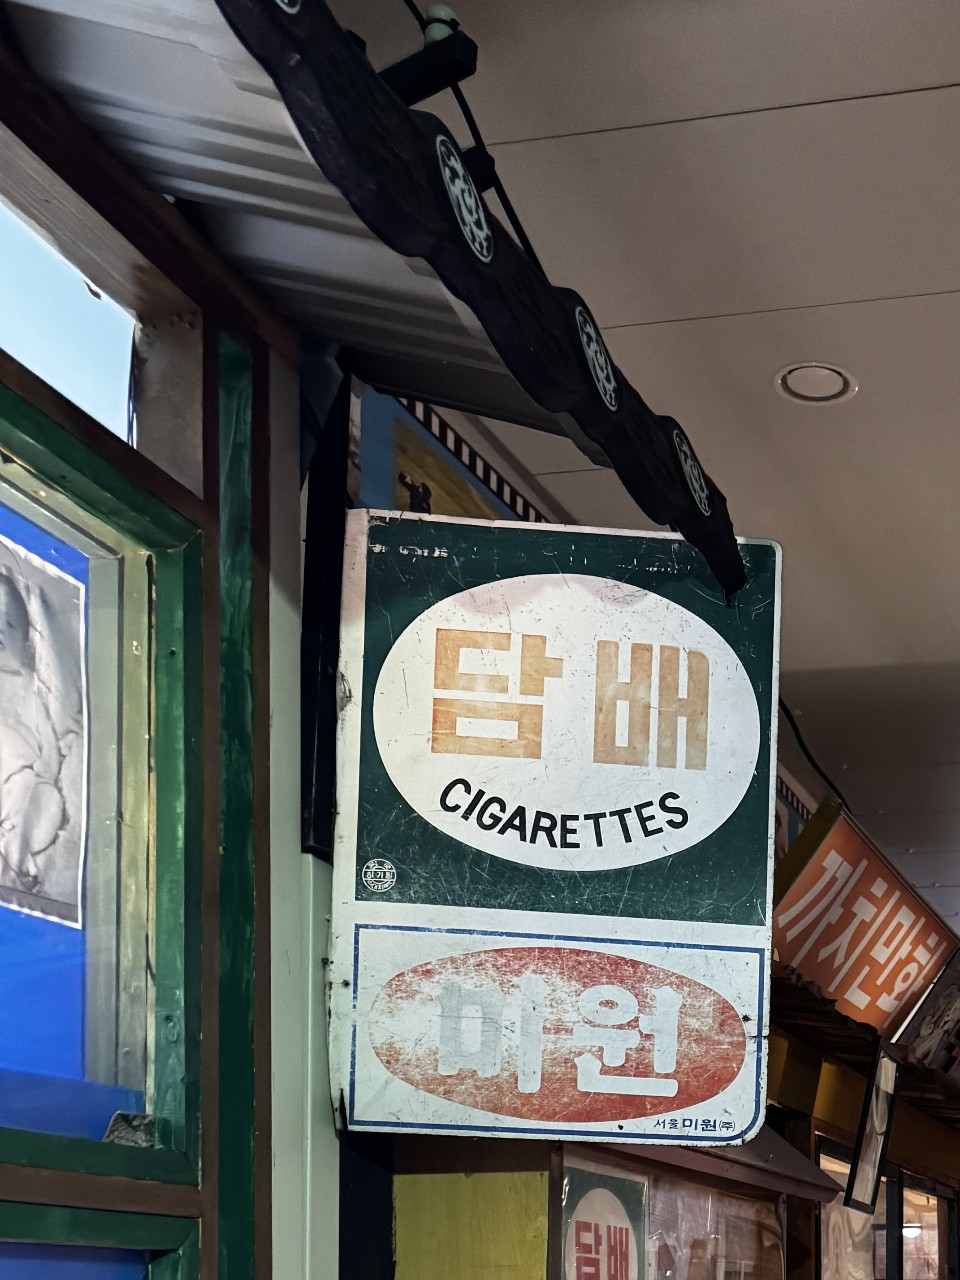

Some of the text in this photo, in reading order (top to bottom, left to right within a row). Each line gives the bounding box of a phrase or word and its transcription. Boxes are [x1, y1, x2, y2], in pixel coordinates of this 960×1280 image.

[431, 628, 710, 770] 담배
[439, 778, 690, 849] CIGARETTES
[778, 849, 947, 1028] 까치만화
[436, 970, 684, 1097] 미원
